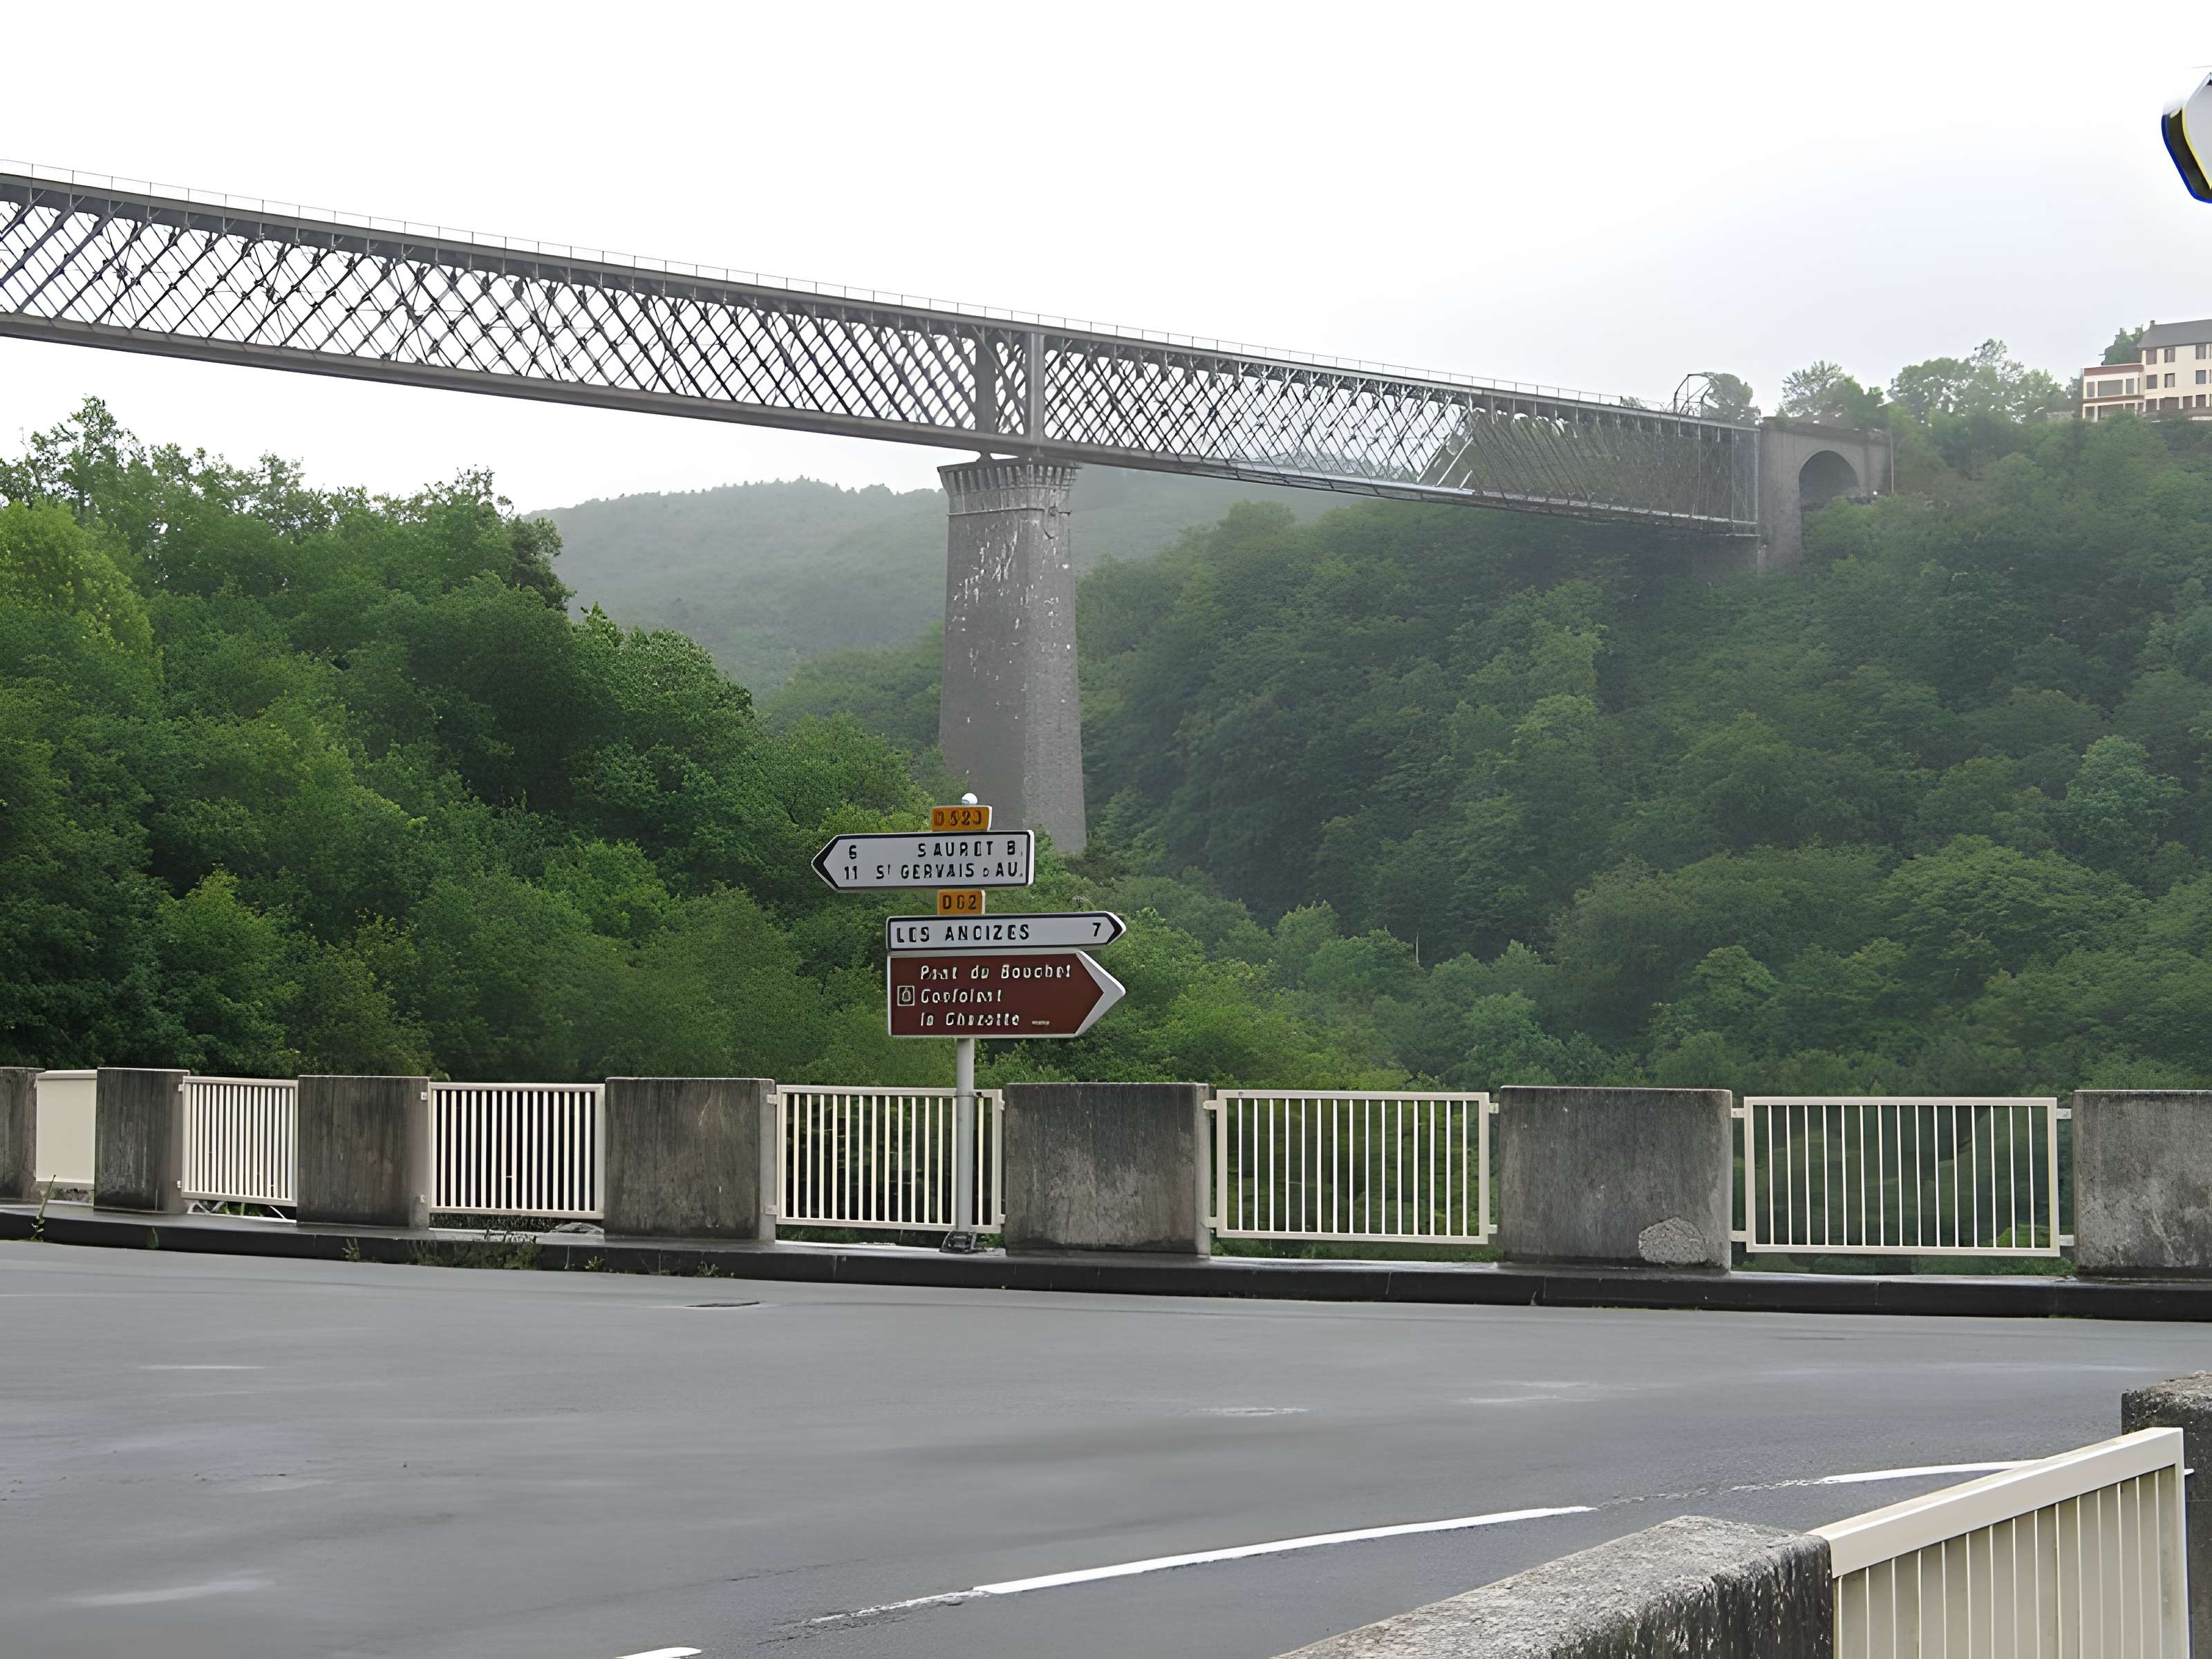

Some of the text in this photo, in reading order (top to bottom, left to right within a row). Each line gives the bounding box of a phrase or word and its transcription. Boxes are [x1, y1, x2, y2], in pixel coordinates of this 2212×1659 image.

[844, 865, 857, 879] 11
[901, 863, 974, 879] GERVAIS
[897, 923, 1101, 942] LES ANCIZES 7
